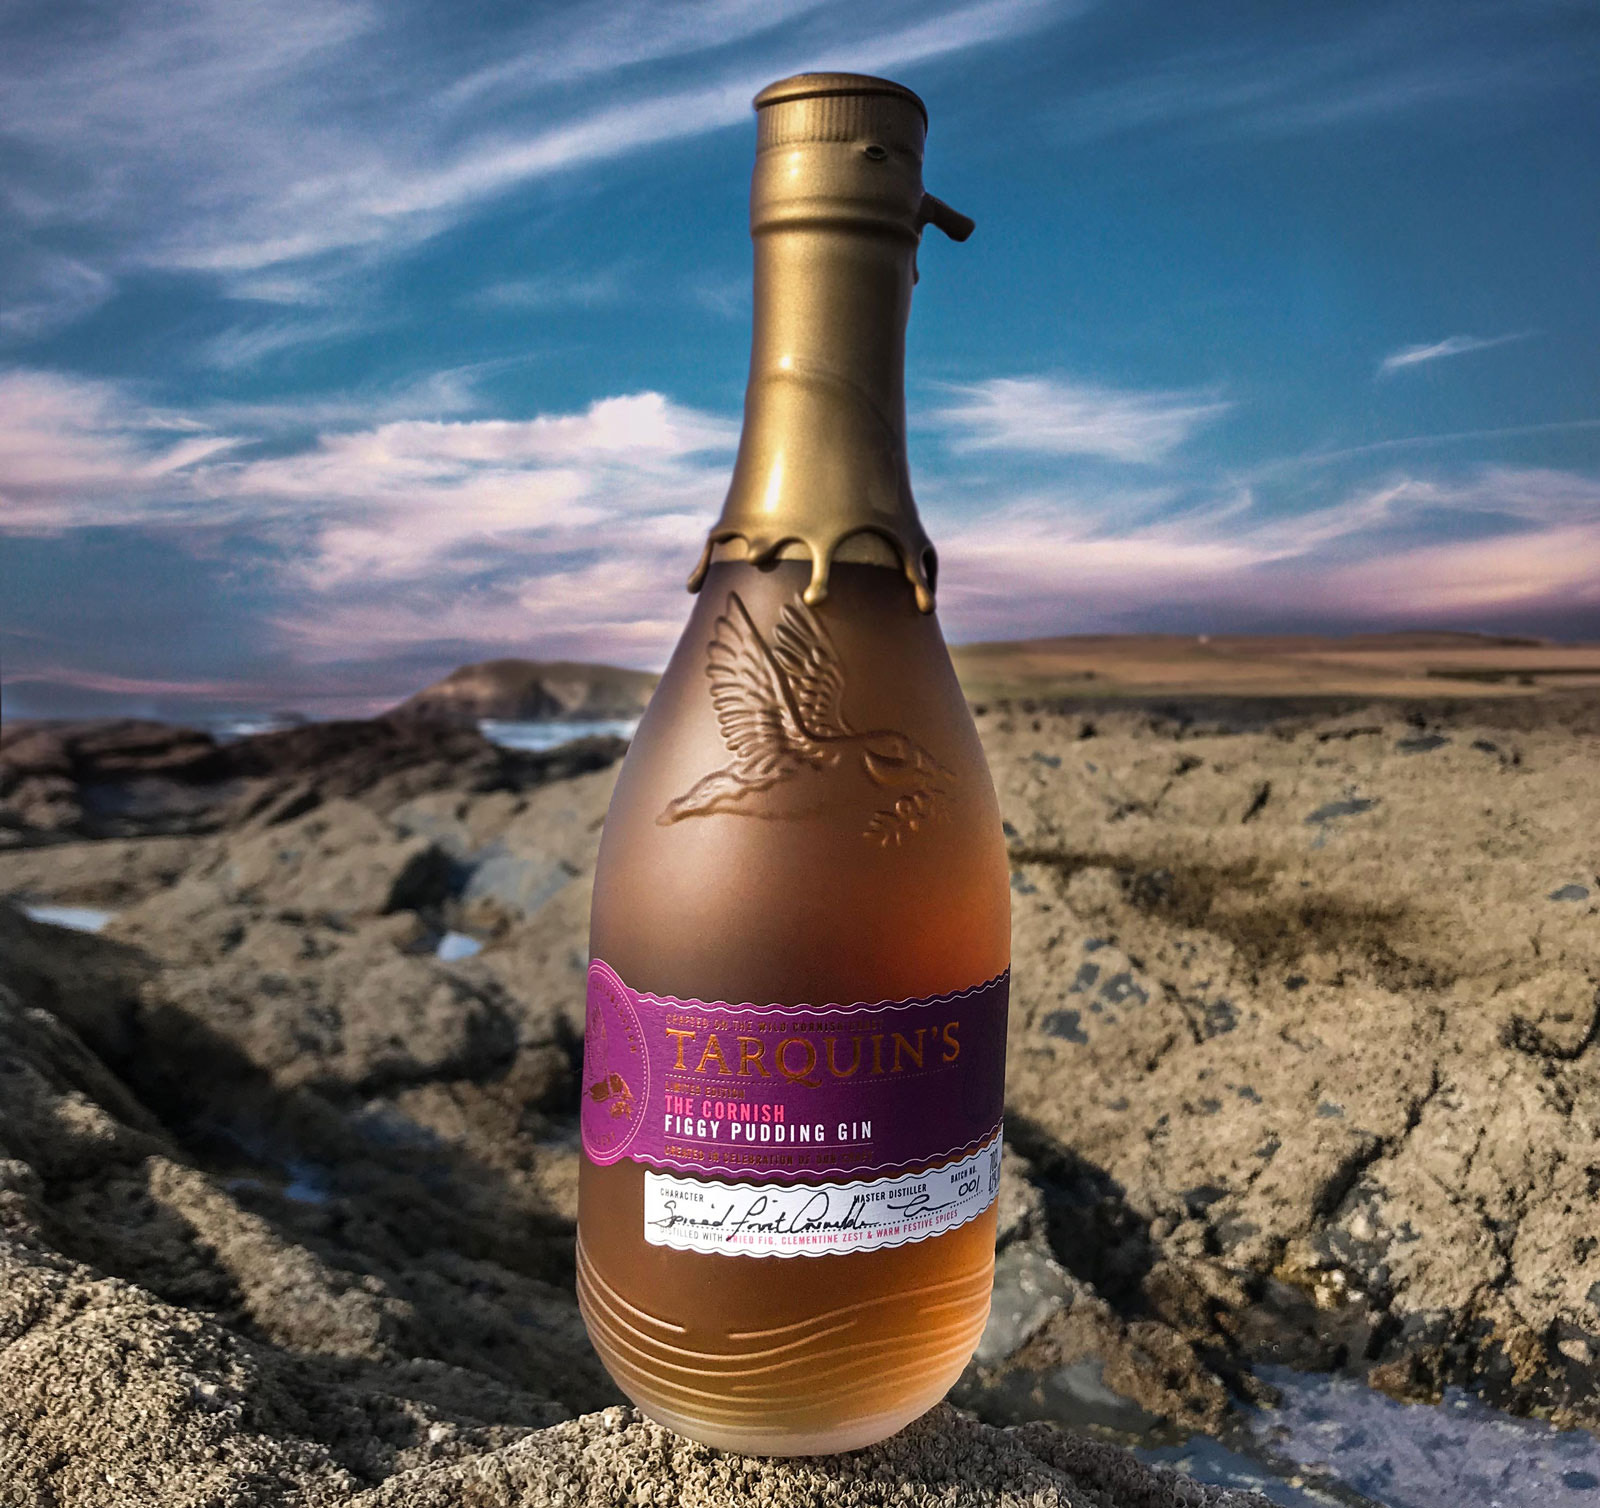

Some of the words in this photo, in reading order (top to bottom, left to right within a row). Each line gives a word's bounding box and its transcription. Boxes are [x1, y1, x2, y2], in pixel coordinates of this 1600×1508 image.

[732, 1020, 753, 1032] THE
[759, 1022, 786, 1033] WILD
[792, 1020, 843, 1033] CORNISH
[665, 1022, 961, 1089] TARQUIN'S
[665, 1080, 701, 1096] LIMITED
[706, 1086, 745, 1100] EDITION
[664, 1095, 694, 1116] THE
[702, 1100, 784, 1123] CORNISH
[664, 1115, 719, 1139] FIGGY
[731, 1123, 825, 1142] PUDDING
[838, 1120, 872, 1141] GIN
[664, 1145, 704, 1162] CREATED
[708, 1152, 720, 1163] IN
[724, 1152, 793, 1166] CELEBRATION
[798, 1154, 811, 1165] OF
[950, 1168, 968, 1184] BATCH
[660, 1188, 704, 1202] CHARACTER
[854, 1189, 886, 1204] MASTER
[889, 1184, 927, 1200] DISTILLER
[703, 1232, 723, 1242] WITH
[758, 1235, 778, 1246] FIG,
[781, 1234, 838, 1246] CLEMENTINE
[842, 1232, 863, 1244] ZEST
[866, 1230, 872, 1240] &
[876, 1226, 900, 1239] WARM
[904, 1220, 933, 1234] FESTIVE
[936, 1210, 958, 1226] SPICES
